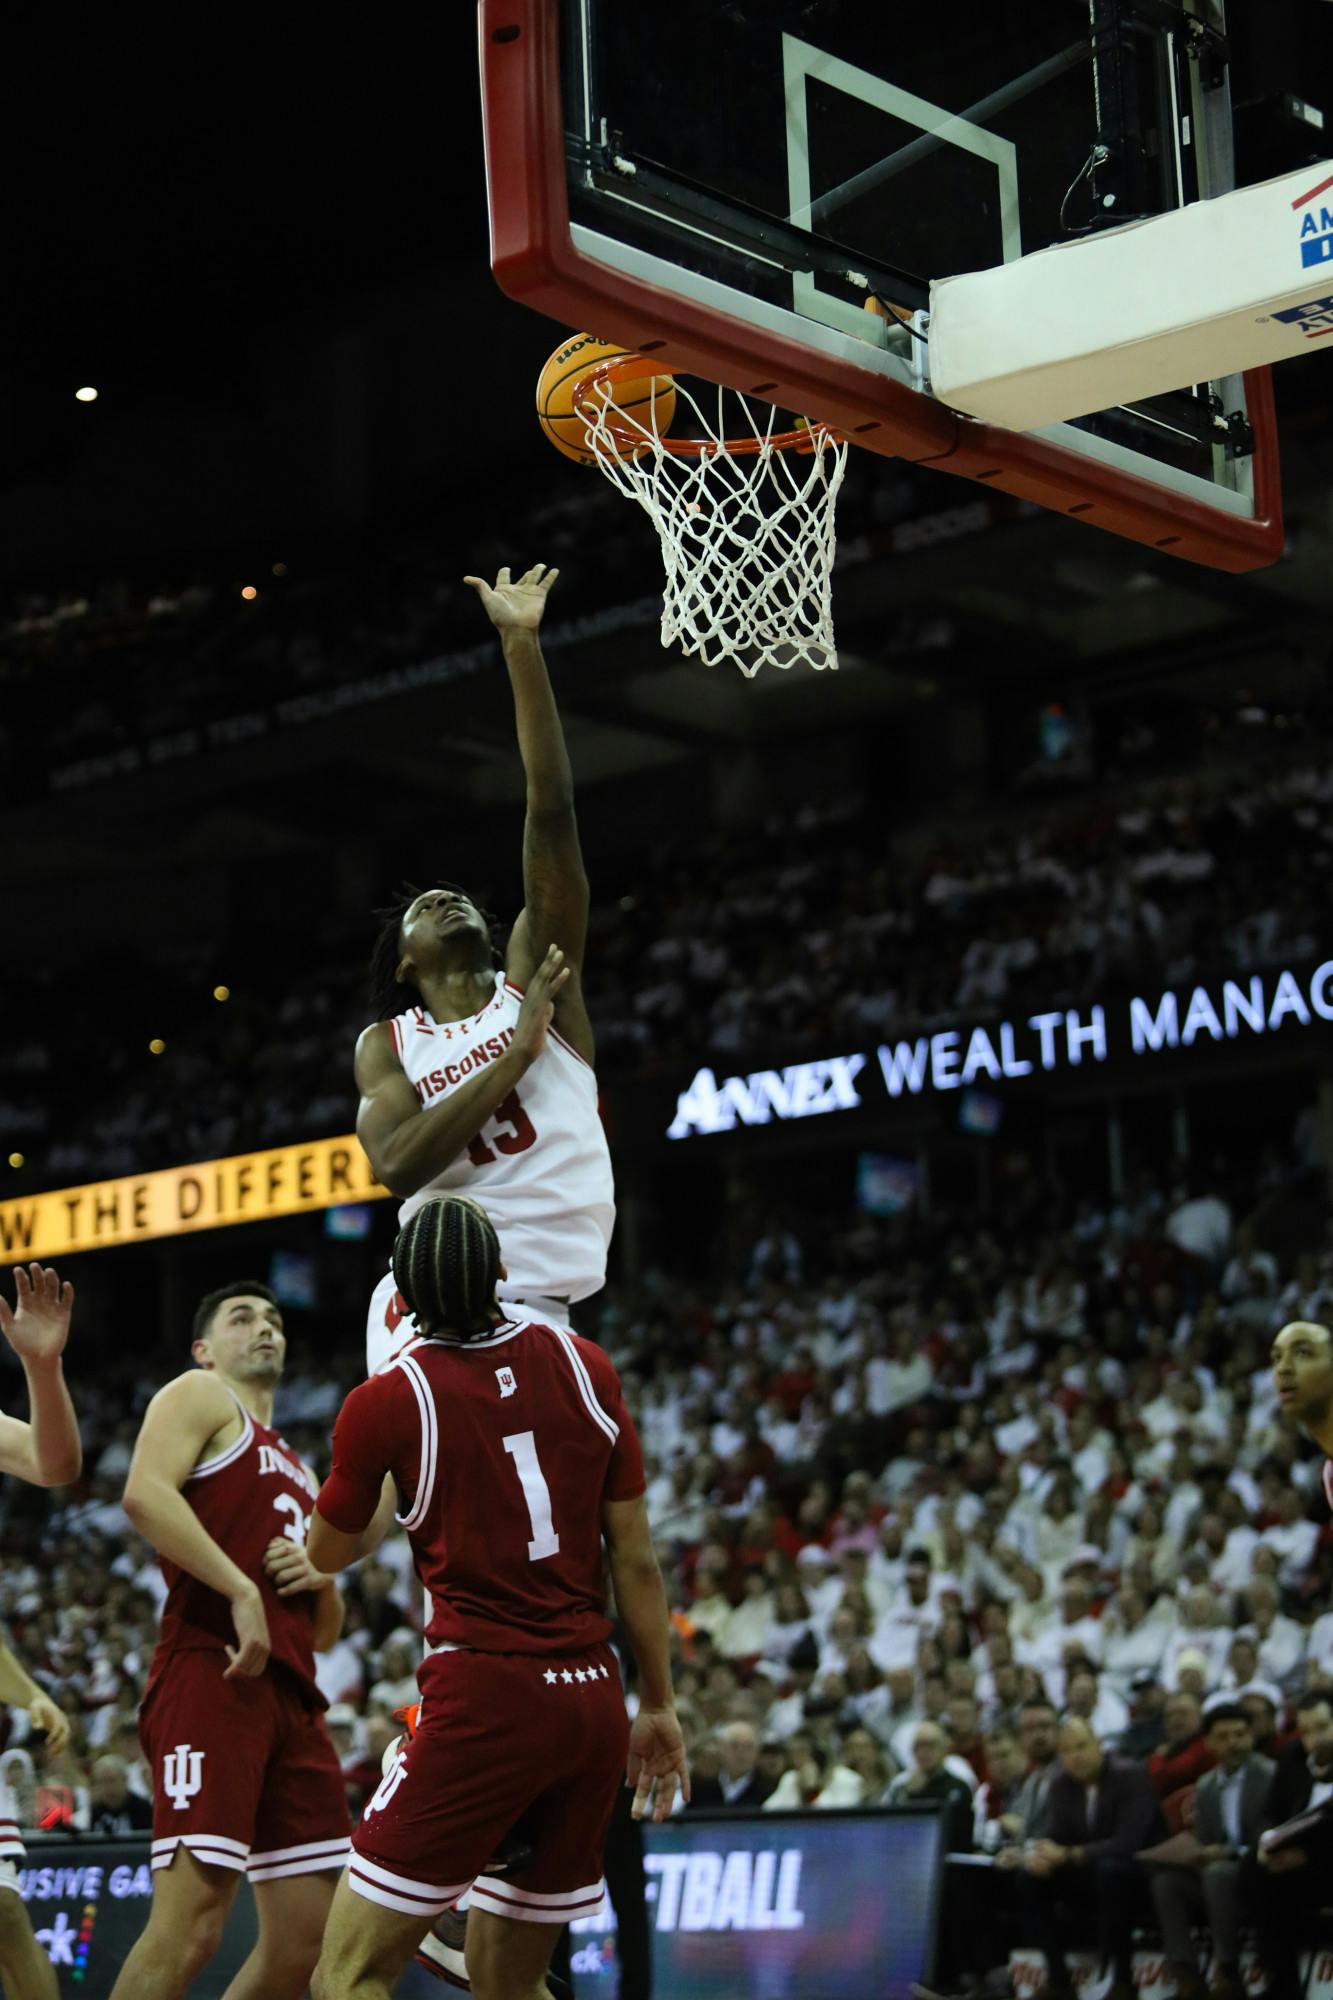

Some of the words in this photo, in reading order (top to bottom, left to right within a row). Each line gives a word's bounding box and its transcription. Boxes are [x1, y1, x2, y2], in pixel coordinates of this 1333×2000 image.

[665, 1050, 868, 1141] ANNEX
[876, 1003, 1109, 1099] WEALTH
[66, 1185, 147, 1240] THE
[177, 1150, 378, 1221] DIFFER
[272, 1491, 312, 1547] 3
[502, 1430, 560, 1561] 1
